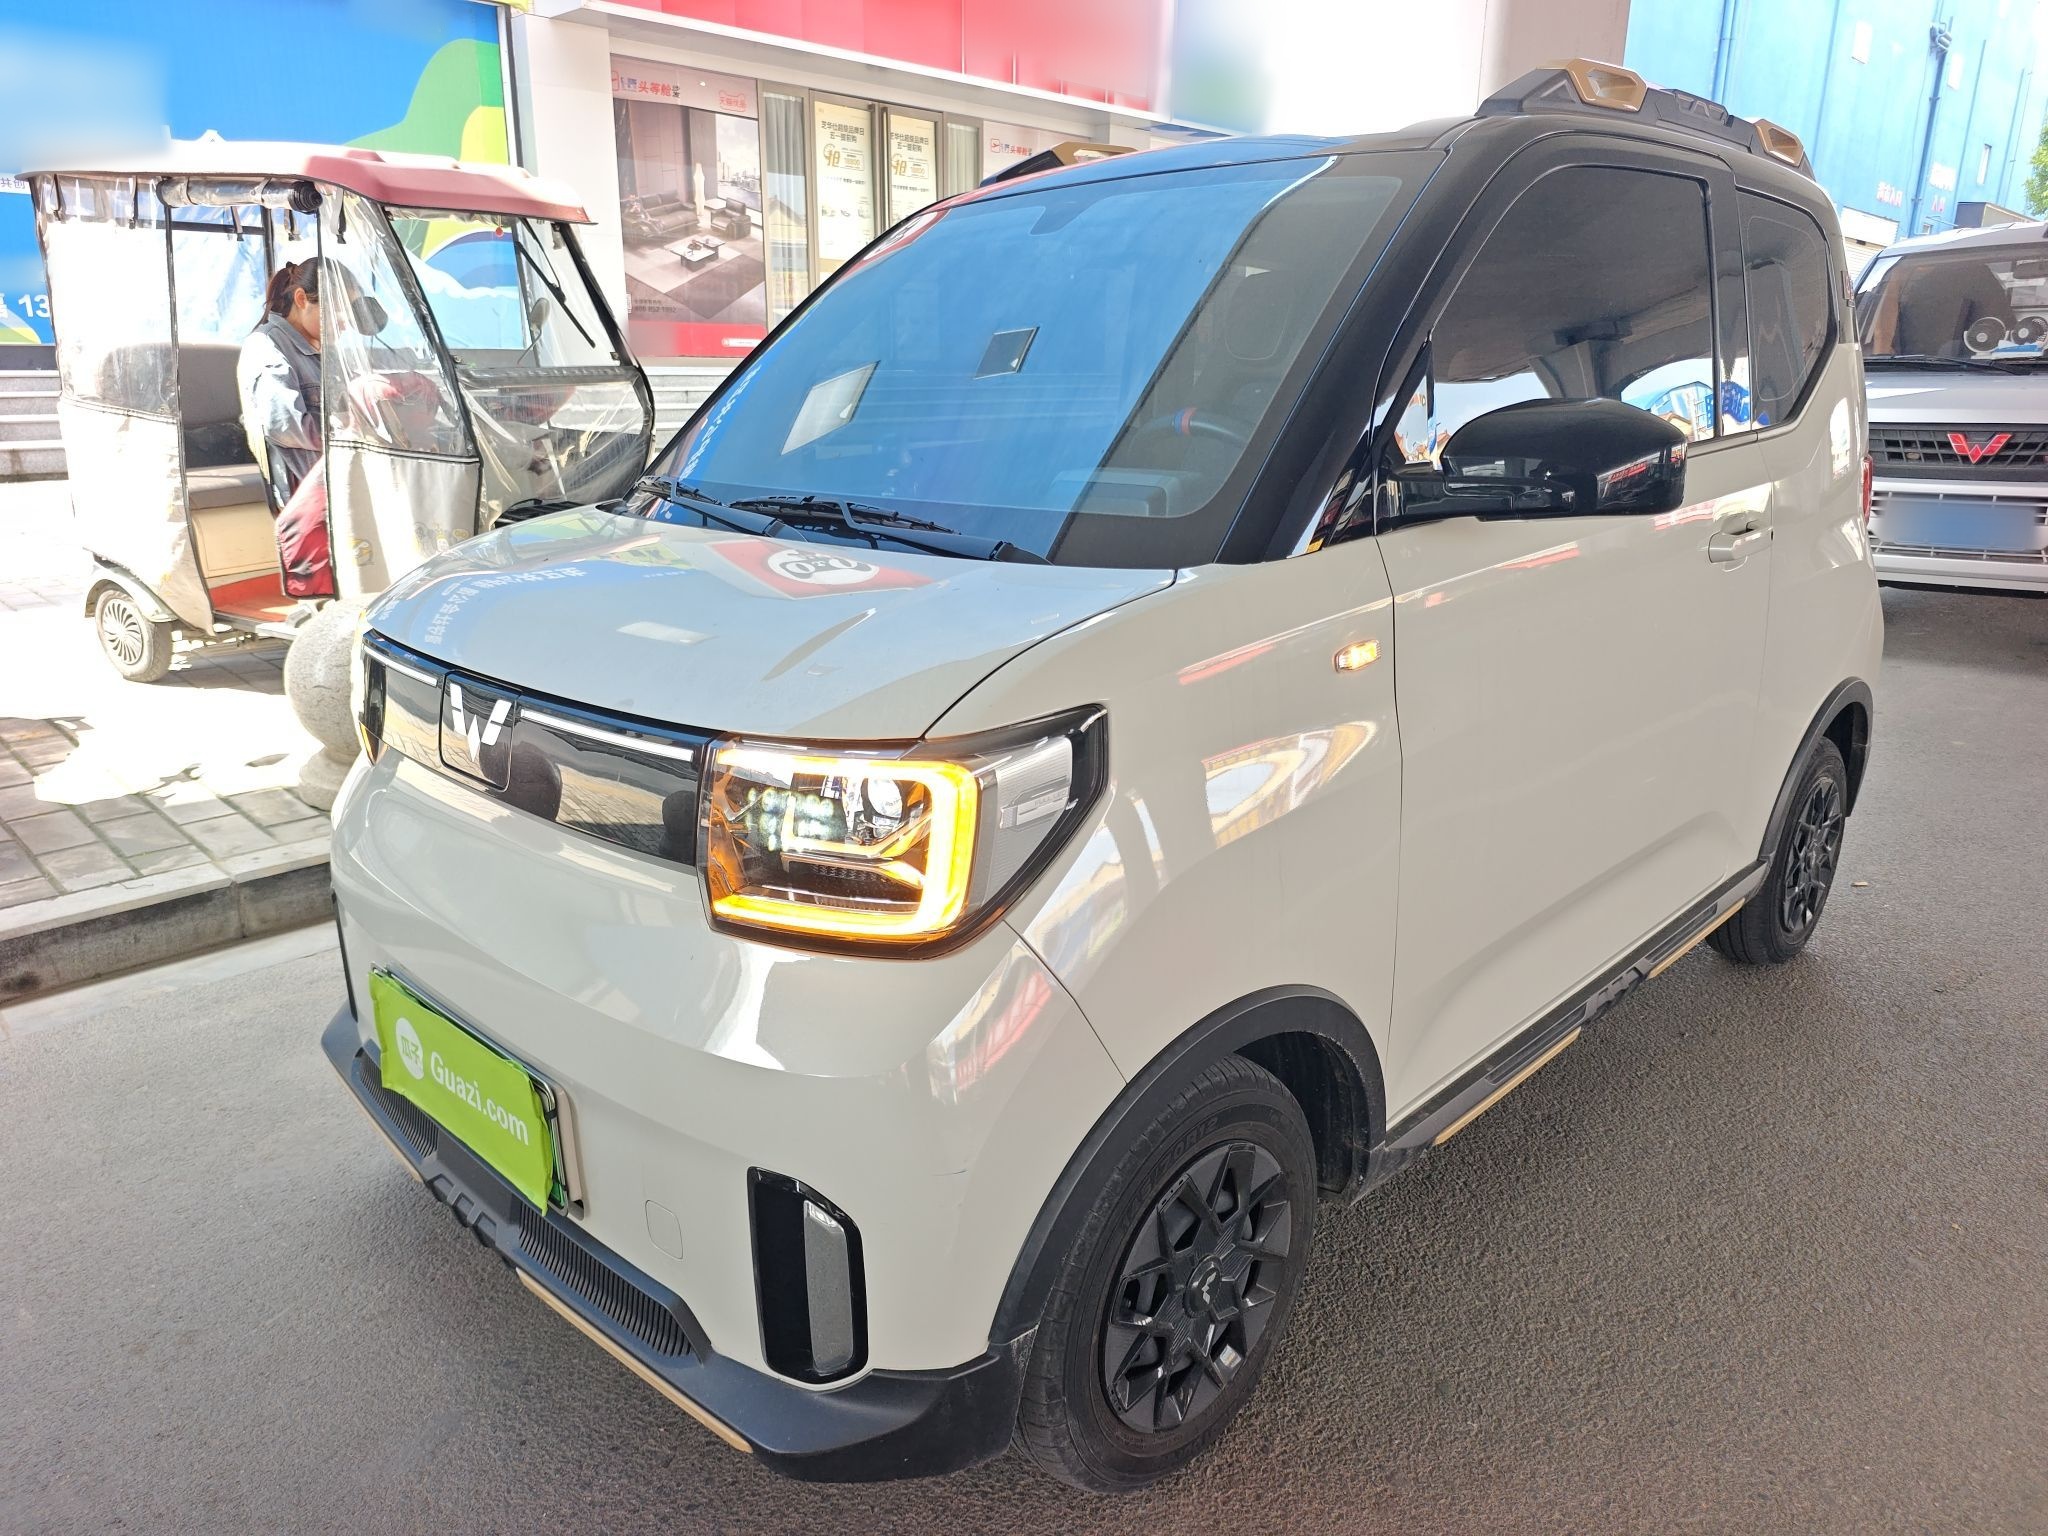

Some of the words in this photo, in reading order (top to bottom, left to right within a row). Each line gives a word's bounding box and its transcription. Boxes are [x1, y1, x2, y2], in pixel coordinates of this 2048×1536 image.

[638, 80, 672, 97] 头等舱
[430, 1051, 529, 1147] Guazi.com
